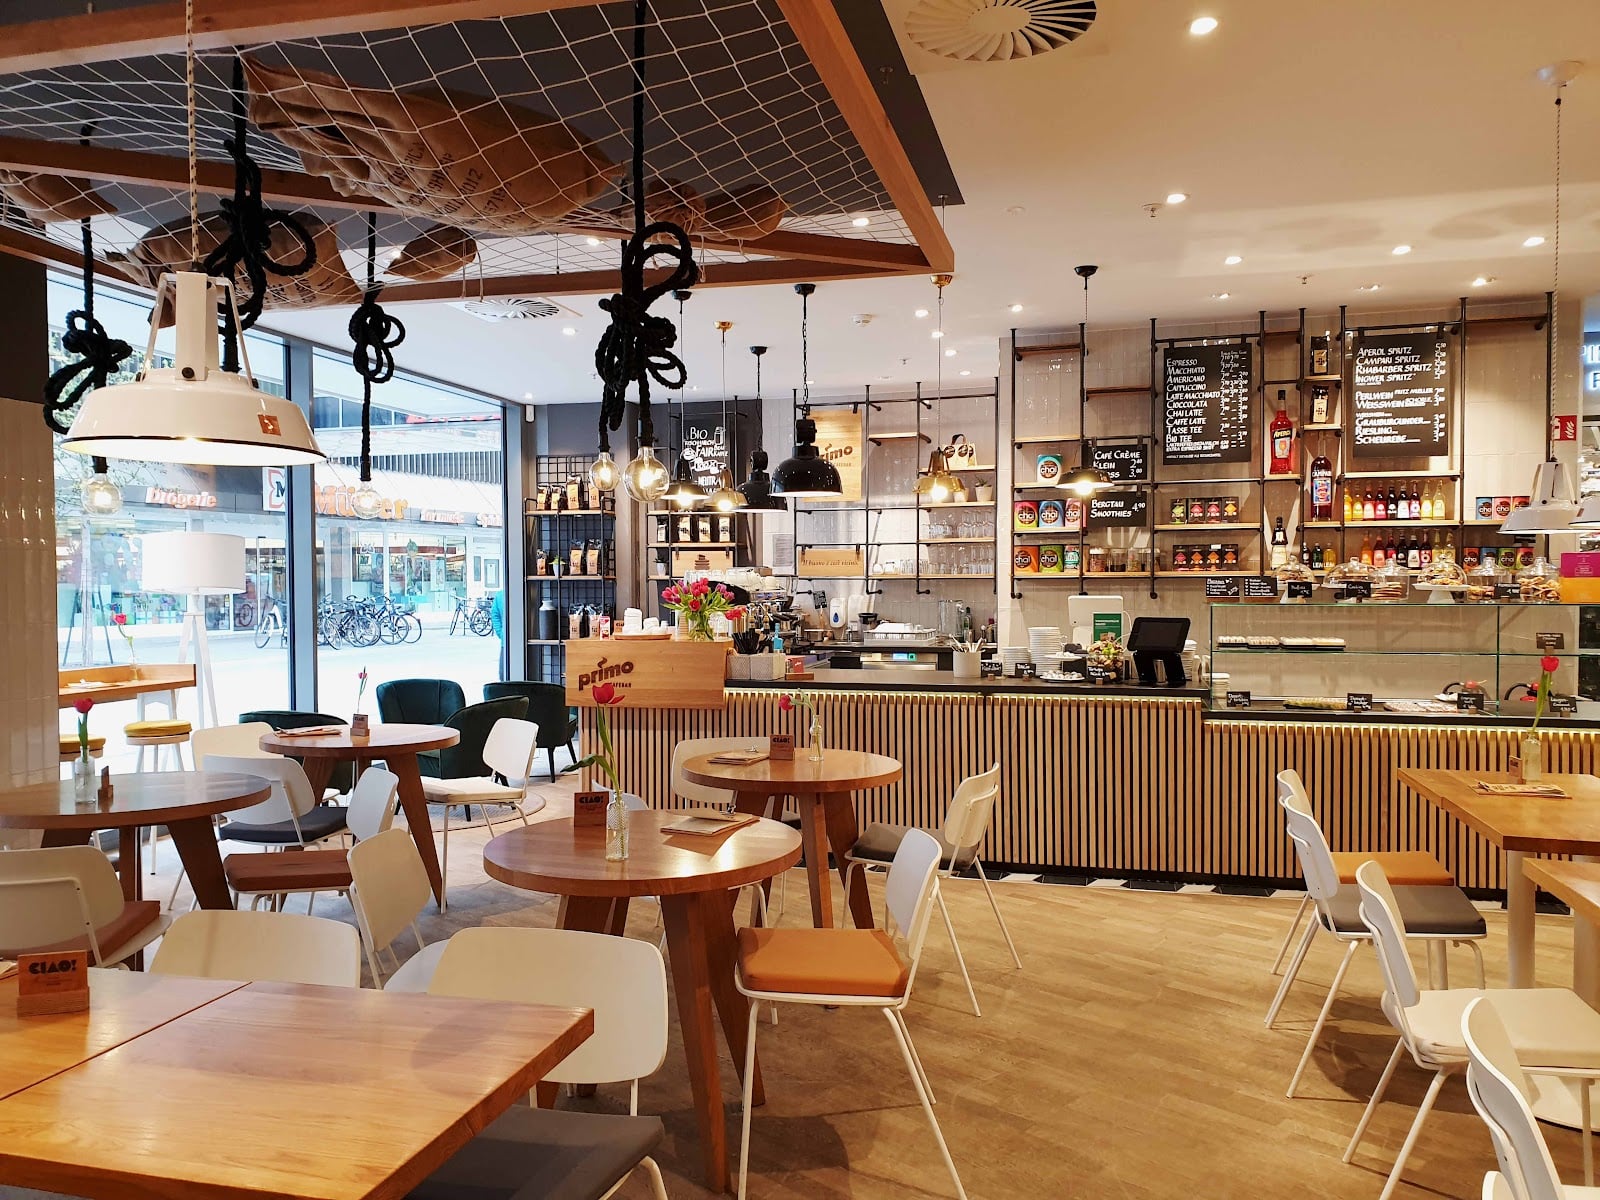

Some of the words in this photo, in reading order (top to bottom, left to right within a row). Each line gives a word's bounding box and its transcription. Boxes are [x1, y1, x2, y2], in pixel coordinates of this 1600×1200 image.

[1357, 348, 1386, 356] APEROL
[1388, 346, 1412, 355] SPRITZ
[1166, 358, 1198, 367] ESPRESSO
[1356, 356, 1392, 366] CAMPARI
[1394, 355, 1420, 364] SPRITZ
[1166, 367, 1206, 375] MACCHIATO
[1356, 365, 1404, 374] RHABARBER
[1404, 363, 1432, 372] SPRITZ
[1166, 375, 1206, 384] AMERICANO
[1355, 374, 1384, 383] INGWER
[1166, 384, 1206, 392] CAPPUCCINO
[1355, 391, 1394, 400] PERLWEIN
[1166, 400, 1208, 408] CIOCCOLATA
[1356, 400, 1404, 409] WEISSWEIN
[1166, 409, 1184, 418] CHAI
[1184, 408, 1204, 416] LATTE
[1189, 417, 1207, 425] LATTE
[1356, 416, 1424, 426] GRAUBURGUNDER
[1166, 426, 1188, 434] TASSE
[1190, 426, 1203, 434] TEE
[1355, 426, 1392, 436] RIESLING
[1166, 434, 1178, 443] BIO
[1180, 434, 1192, 442] TEE
[696, 444, 714, 458] FAIR
[1114, 450, 1140, 459] CRÈME
[1040, 465, 1058, 474] chai
[1093, 460, 1116, 470] KLEIN
[146, 487, 217, 508] Drogerie
[314, 482, 408, 520] Müer
[1092, 499, 1124, 508] BERGTAU
[1018, 511, 1034, 520] chai
[1041, 510, 1058, 518] chai
[1066, 510, 1080, 518] chai
[1090, 508, 1132, 518] SMOOTHIES
[1016, 556, 1030, 564] chai
[1040, 555, 1058, 564] chai
[578, 657, 634, 692] primo
[579, 796, 604, 804] CIAO!
[28, 959, 77, 974] CIAO!
